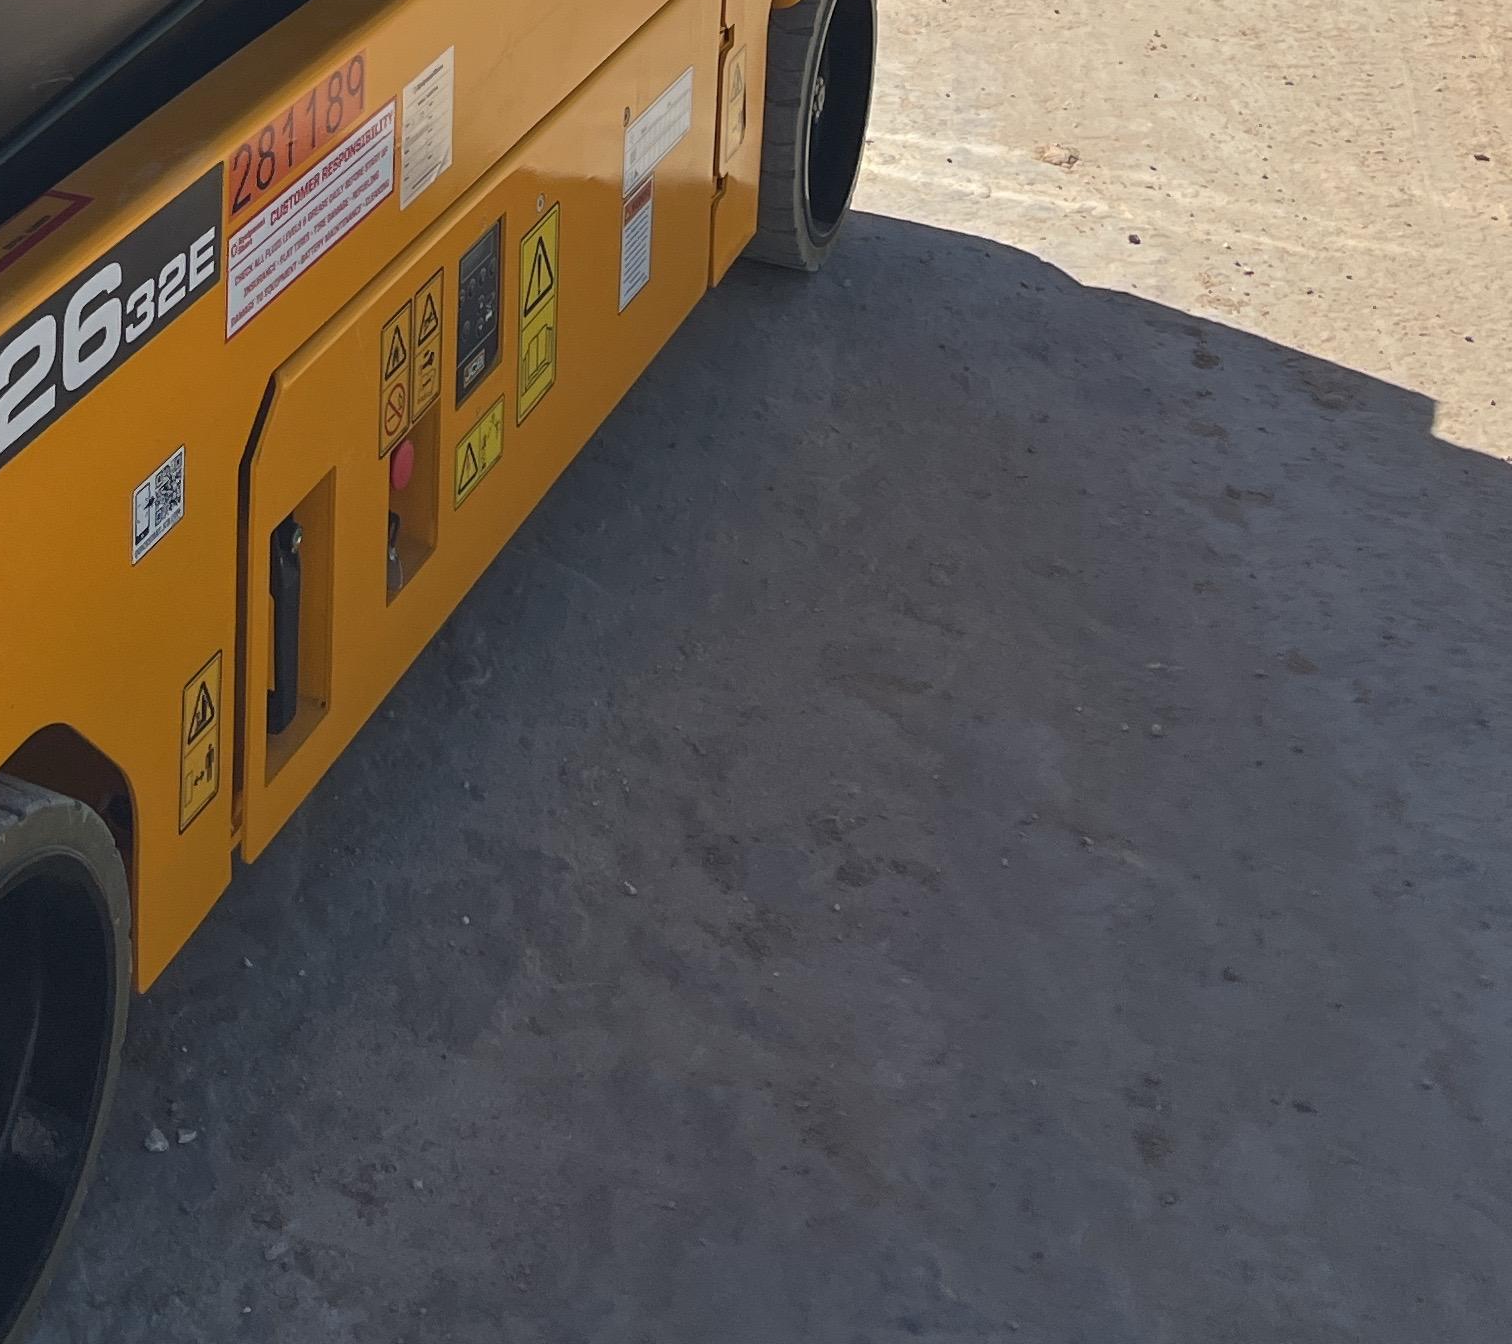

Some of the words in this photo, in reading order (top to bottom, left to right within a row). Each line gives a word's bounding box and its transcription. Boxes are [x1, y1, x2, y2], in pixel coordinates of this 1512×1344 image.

[232, 54, 365, 216] 281189
[270, 171, 319, 226] CUSTOMER
[322, 109, 392, 182] RESPONSIBILITY
